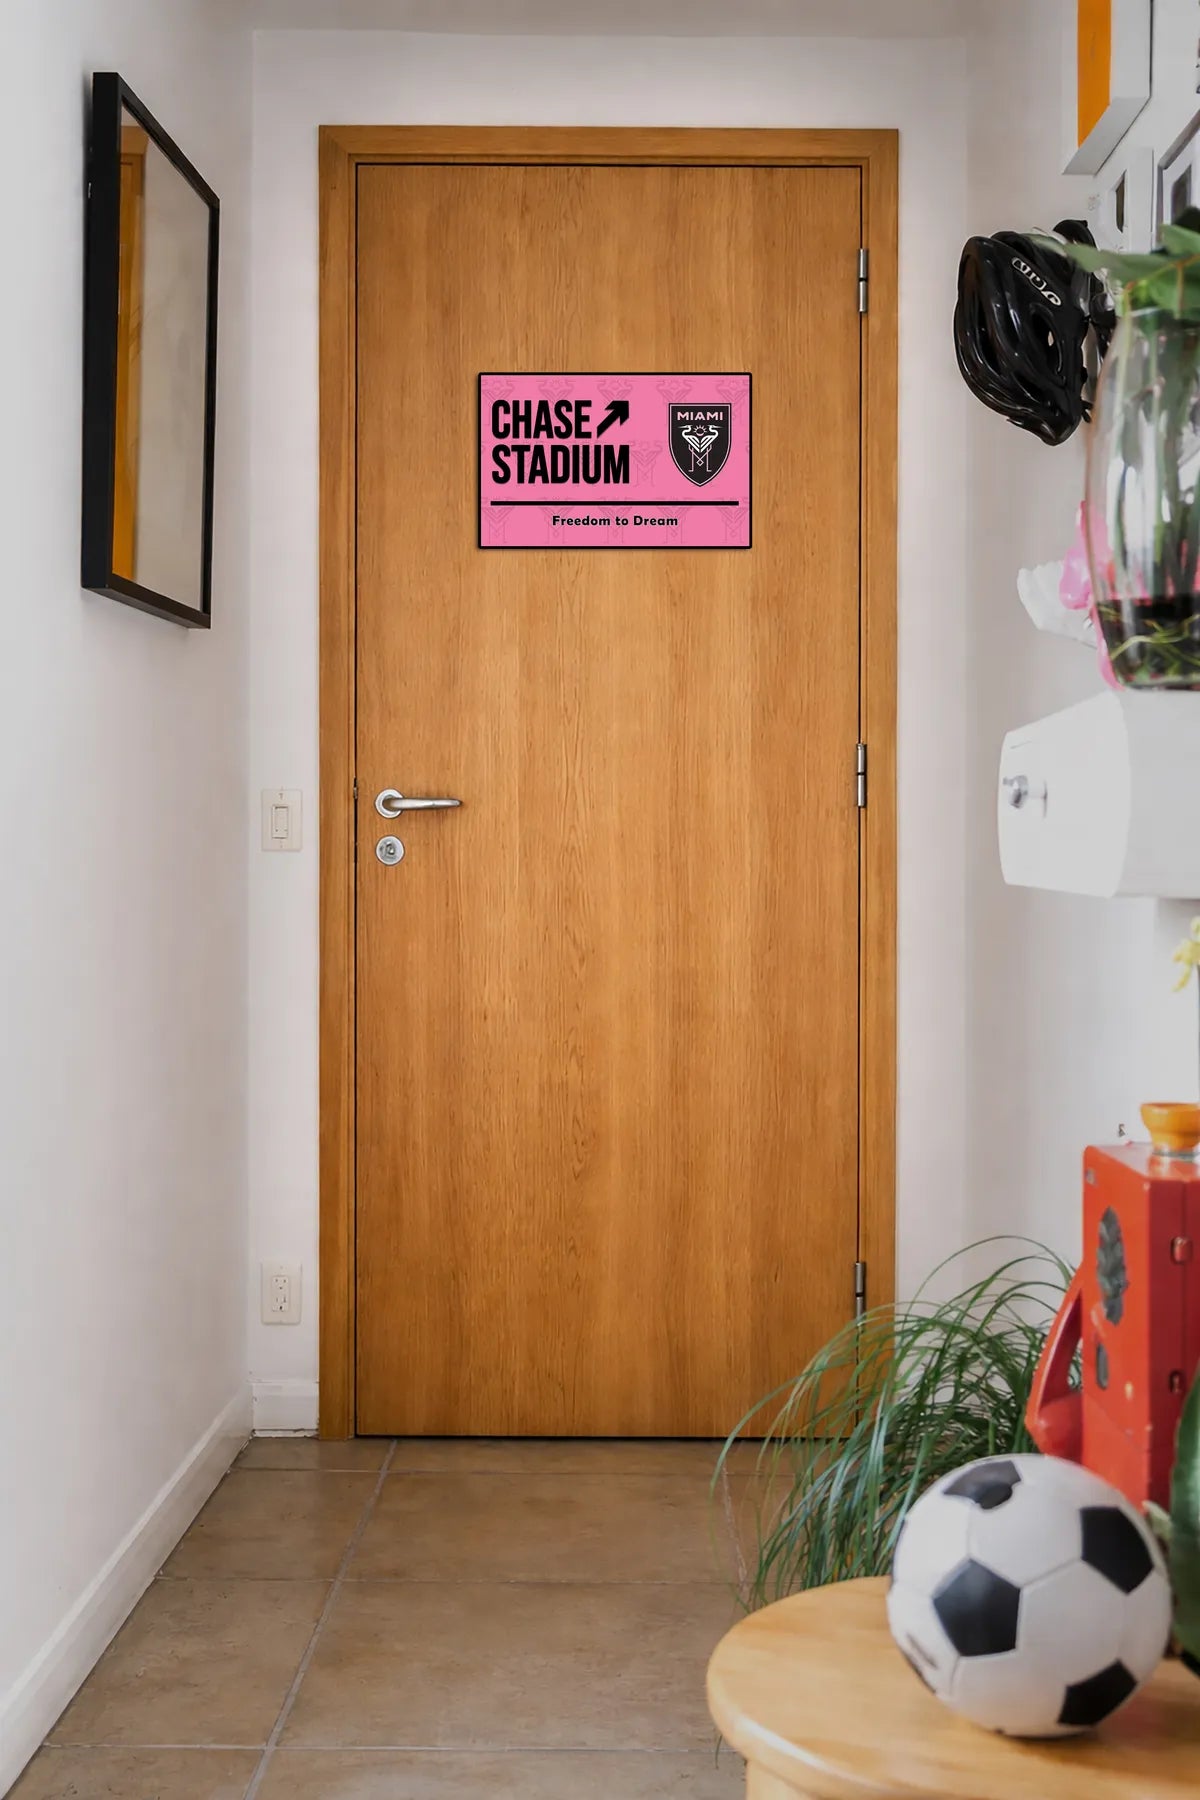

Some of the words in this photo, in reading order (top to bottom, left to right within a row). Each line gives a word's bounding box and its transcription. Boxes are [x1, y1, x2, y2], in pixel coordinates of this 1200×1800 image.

[491, 399, 592, 440] CHASE
[677, 411, 724, 421] MIAMI
[491, 443, 631, 485] STADIUM
[552, 514, 611, 527] Freedom
[615, 515, 629, 527] to
[633, 515, 679, 527] Dream
